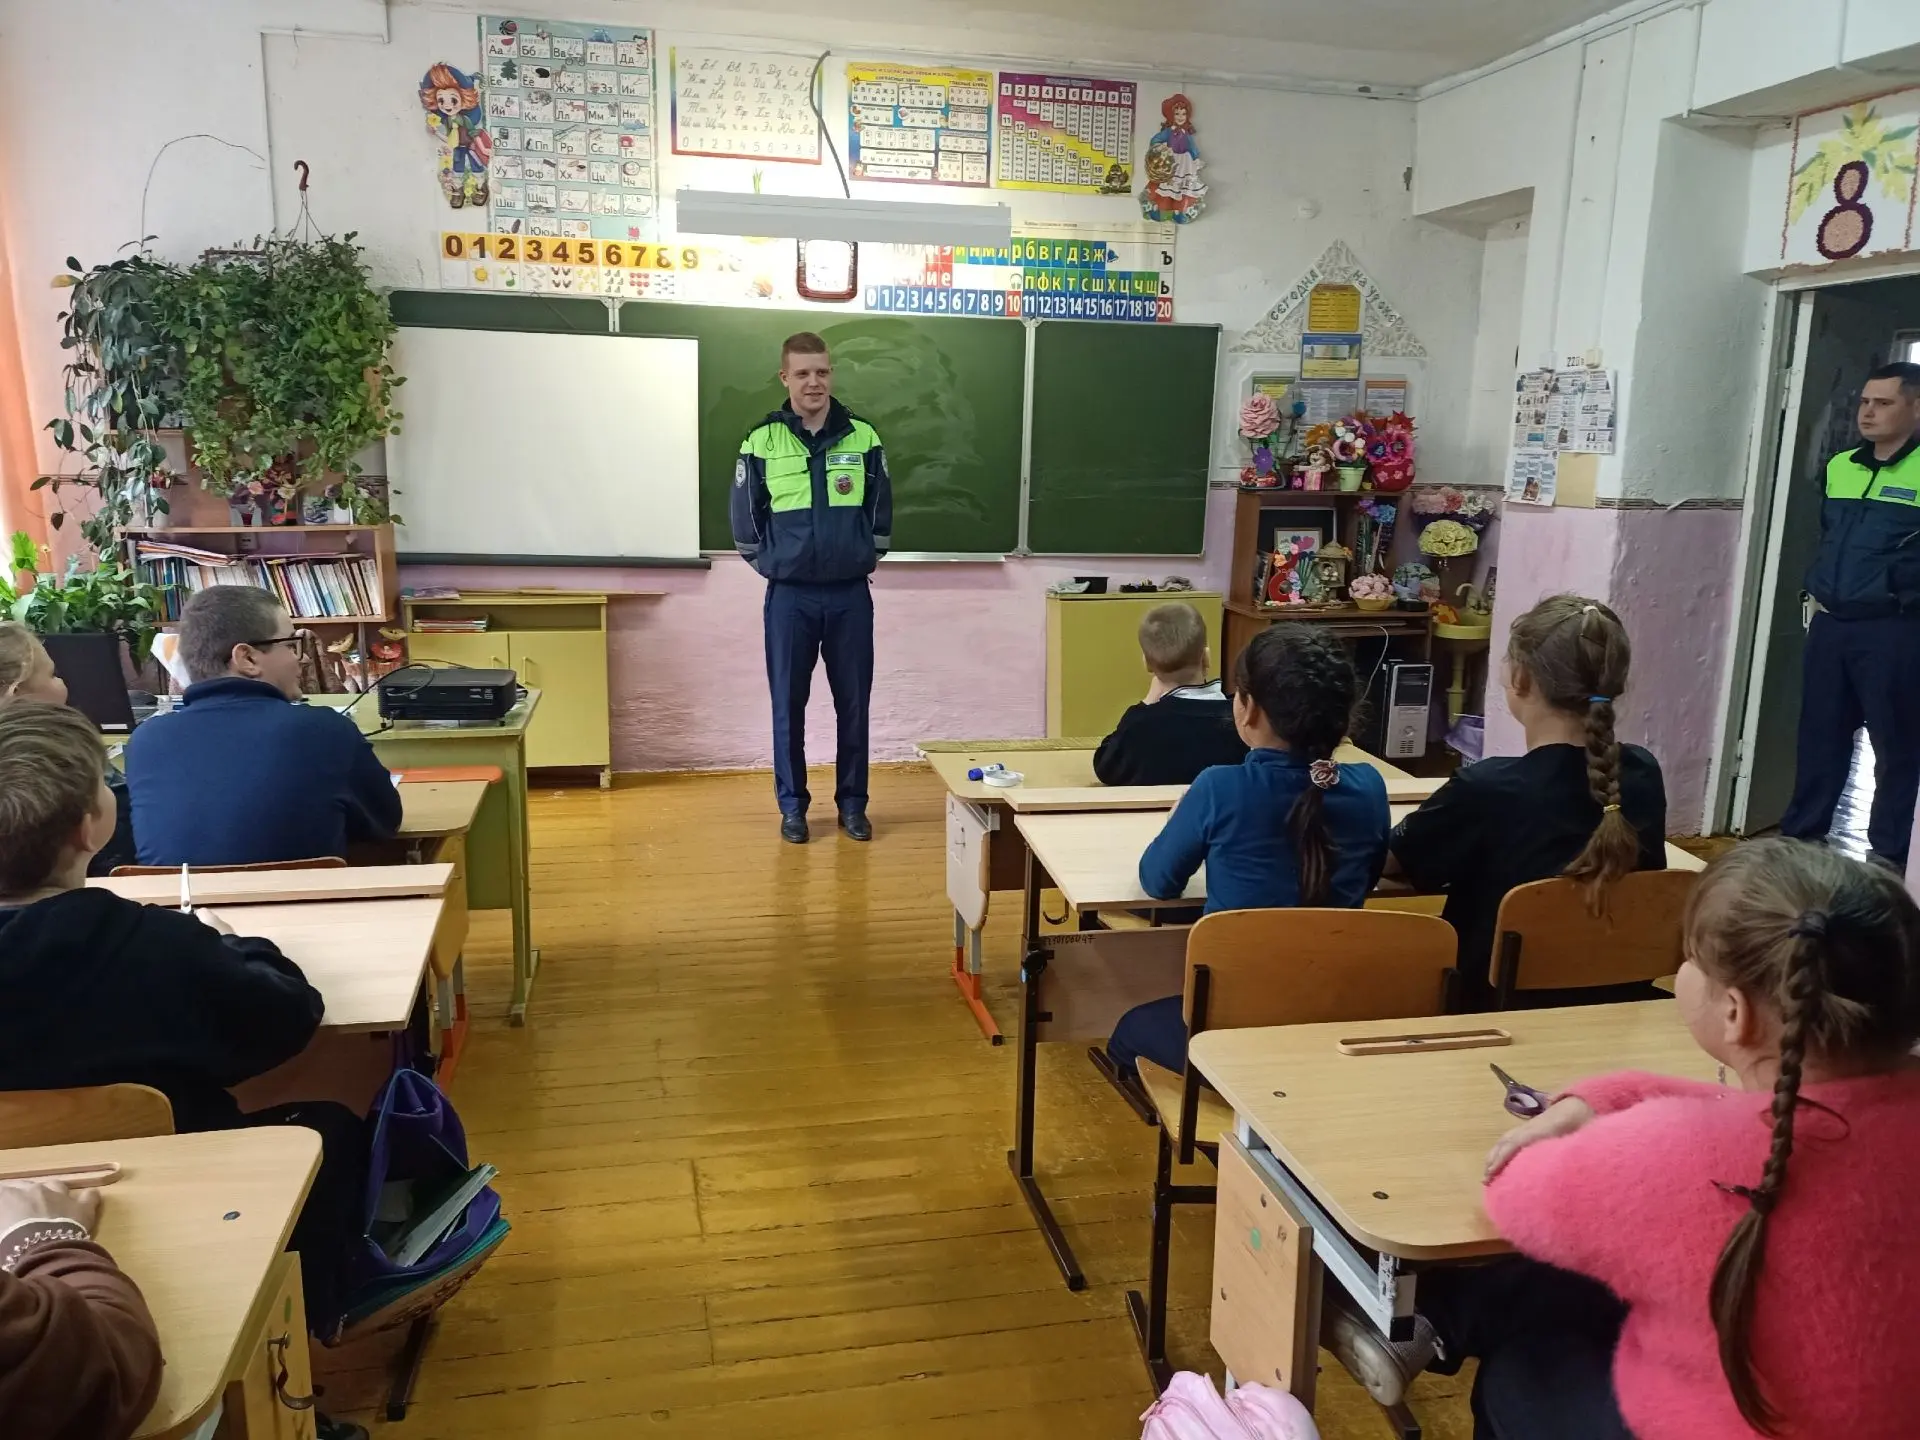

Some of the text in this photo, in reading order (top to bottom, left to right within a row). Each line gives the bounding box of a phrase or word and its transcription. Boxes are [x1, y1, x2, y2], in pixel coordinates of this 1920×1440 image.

[489, 45, 634, 65] Аа Бб Вв Гг Дд
[490, 76, 502, 86] Ее
[555, 84, 575, 93] Жж
[601, 84, 613, 93] Зз
[621, 84, 635, 94] Ии
[1018, 87, 1023, 95] 2
[1045, 88, 1050, 96] 4
[1111, 92, 1116, 100] 9
[491, 104, 636, 122] Йй Кк Лл Мм Нн
[493, 138, 634, 158] Оо Пп Рр Сс Тт
[1016, 123, 1024, 131] 12
[1029, 131, 1037, 139] 13
[1056, 145, 1064, 153] 15
[495, 166, 636, 186] Уу Фф Хх Цц Чч
[496, 198, 516, 208] Шш
[528, 193, 548, 204] Щщ
[445, 235, 463, 257] 0
[472, 237, 486, 258] 1
[498, 238, 516, 259] 2
[526, 240, 543, 261] 3
[552, 241, 570, 262] 4
[579, 242, 595, 263] 5
[605, 244, 622, 265] 6
[631, 245, 647, 266] 7
[682, 249, 699, 269] 9
[1012, 244, 1021, 263] р
[1026, 241, 1036, 256] б
[1040, 247, 1049, 259] в
[1054, 247, 1062, 259] г
[1067, 247, 1078, 264] д
[1082, 249, 1089, 261] з
[1093, 249, 1104, 262] ж
[927, 272, 937, 285] и
[942, 272, 950, 286] е
[1025, 276, 1034, 289] п
[1037, 272, 1049, 292] ф
[1052, 277, 1061, 290] к
[1067, 278, 1076, 290] т
[1082, 278, 1089, 291] с
[1092, 278, 1104, 292] ш
[1107, 279, 1116, 292] х
[1119, 279, 1129, 297] ц
[1134, 279, 1143, 293] ч
[1147, 280, 1157, 297] щ
[1160, 281, 1170, 294] ь
[866, 288, 1172, 318] 0 1 2 3 4 5 6 7 8 9 10 11 12 13 14 15 16 17 18 19 20
